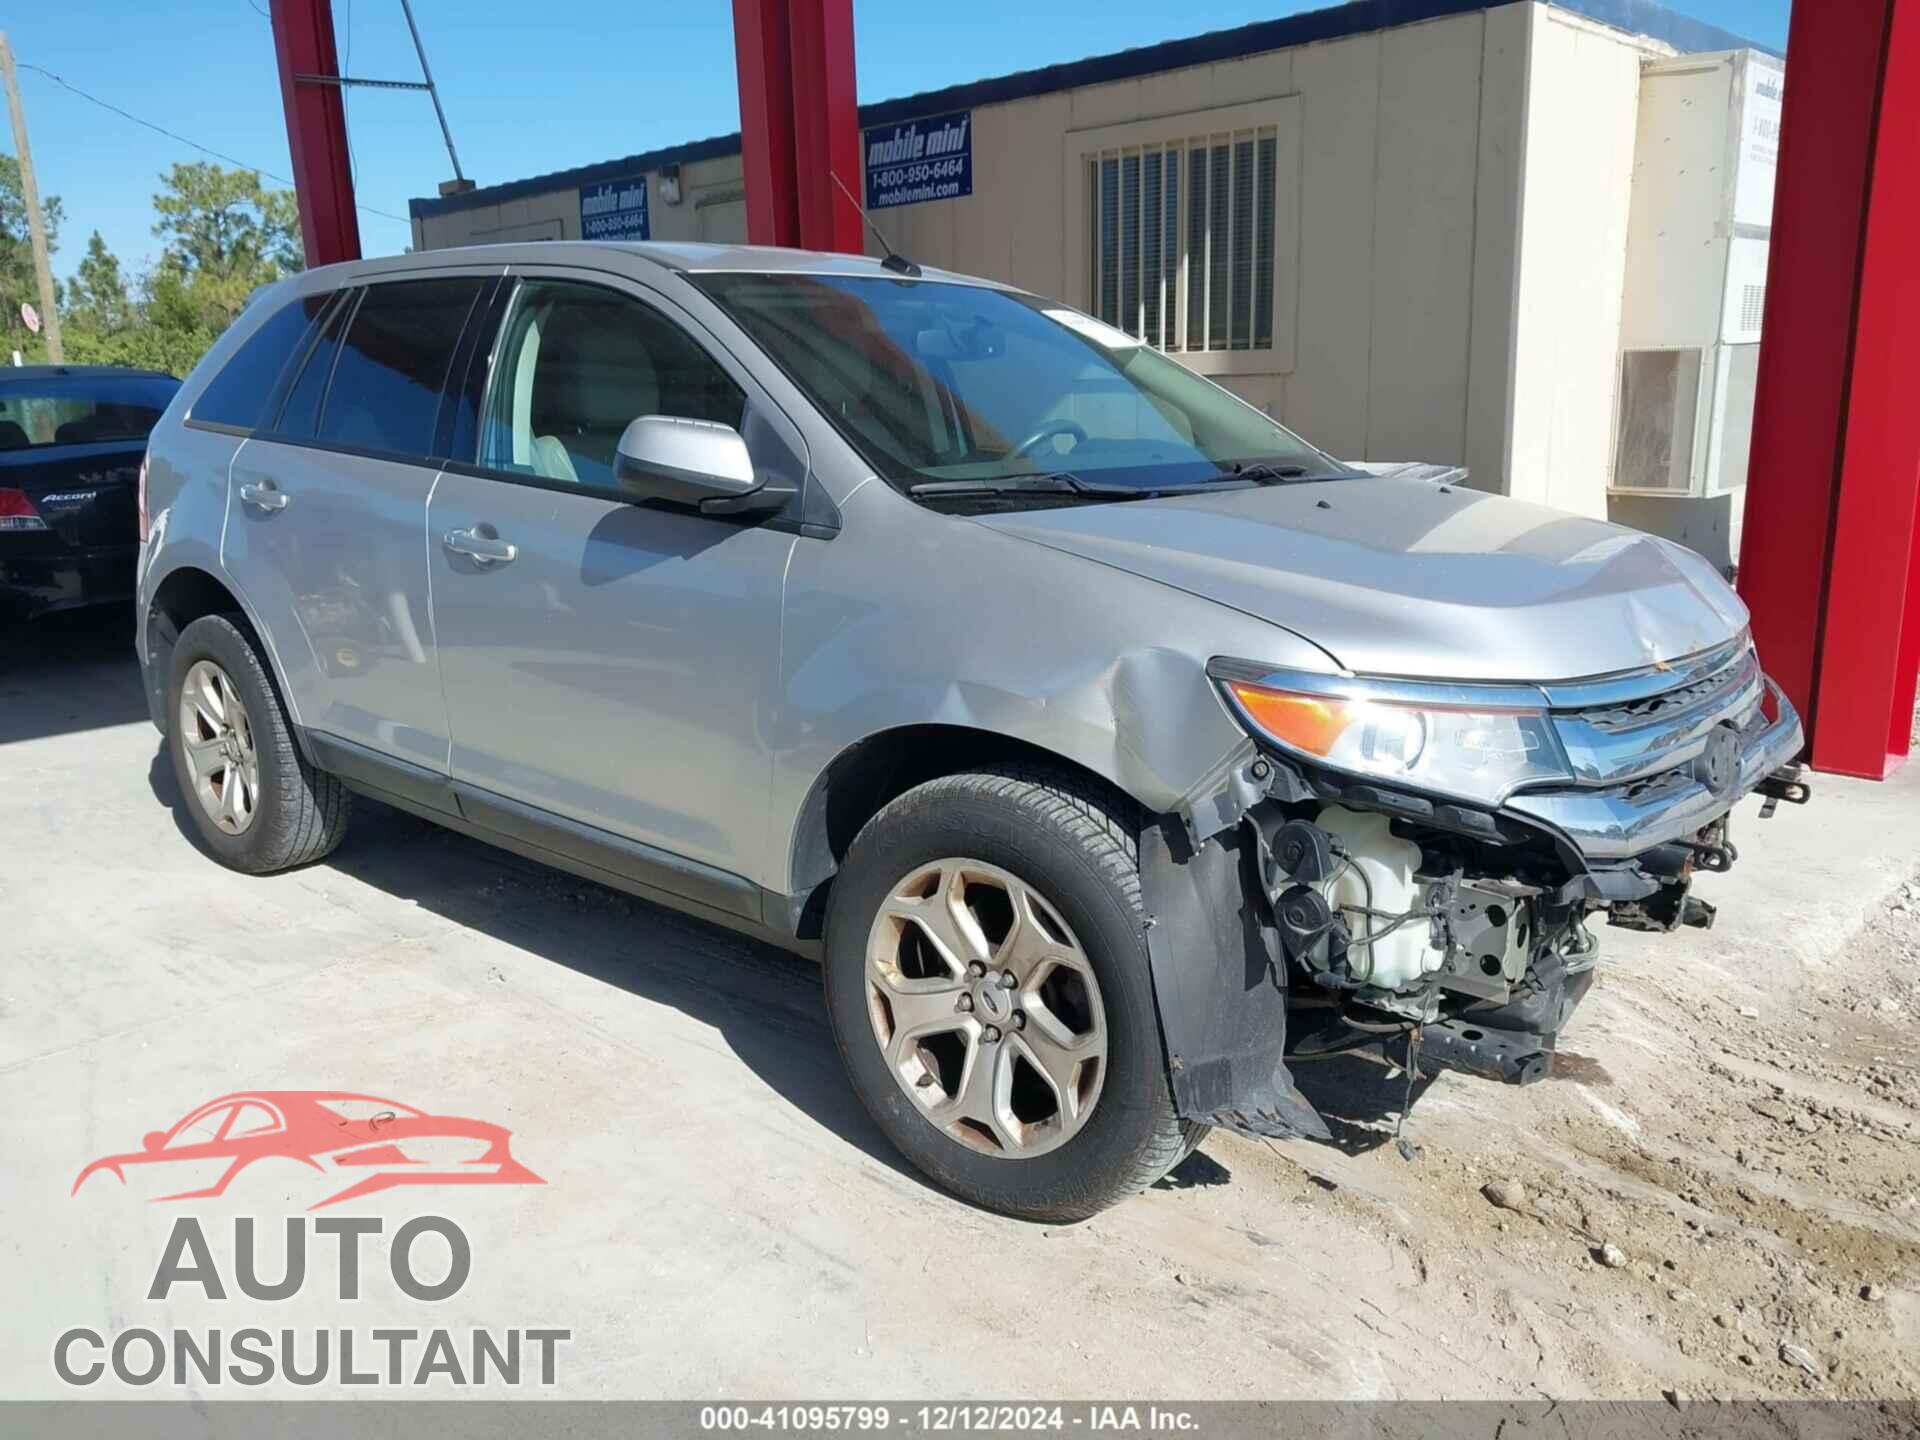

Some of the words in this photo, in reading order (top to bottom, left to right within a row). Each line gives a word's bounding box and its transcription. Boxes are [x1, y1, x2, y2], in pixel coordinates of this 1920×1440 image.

[868, 124, 924, 166] mobile
[926, 119, 967, 156] mini
[873, 158, 963, 189] 1-800-950-6464
[879, 182, 959, 206] mobilemini.com
[41, 491, 97, 503] Accord
